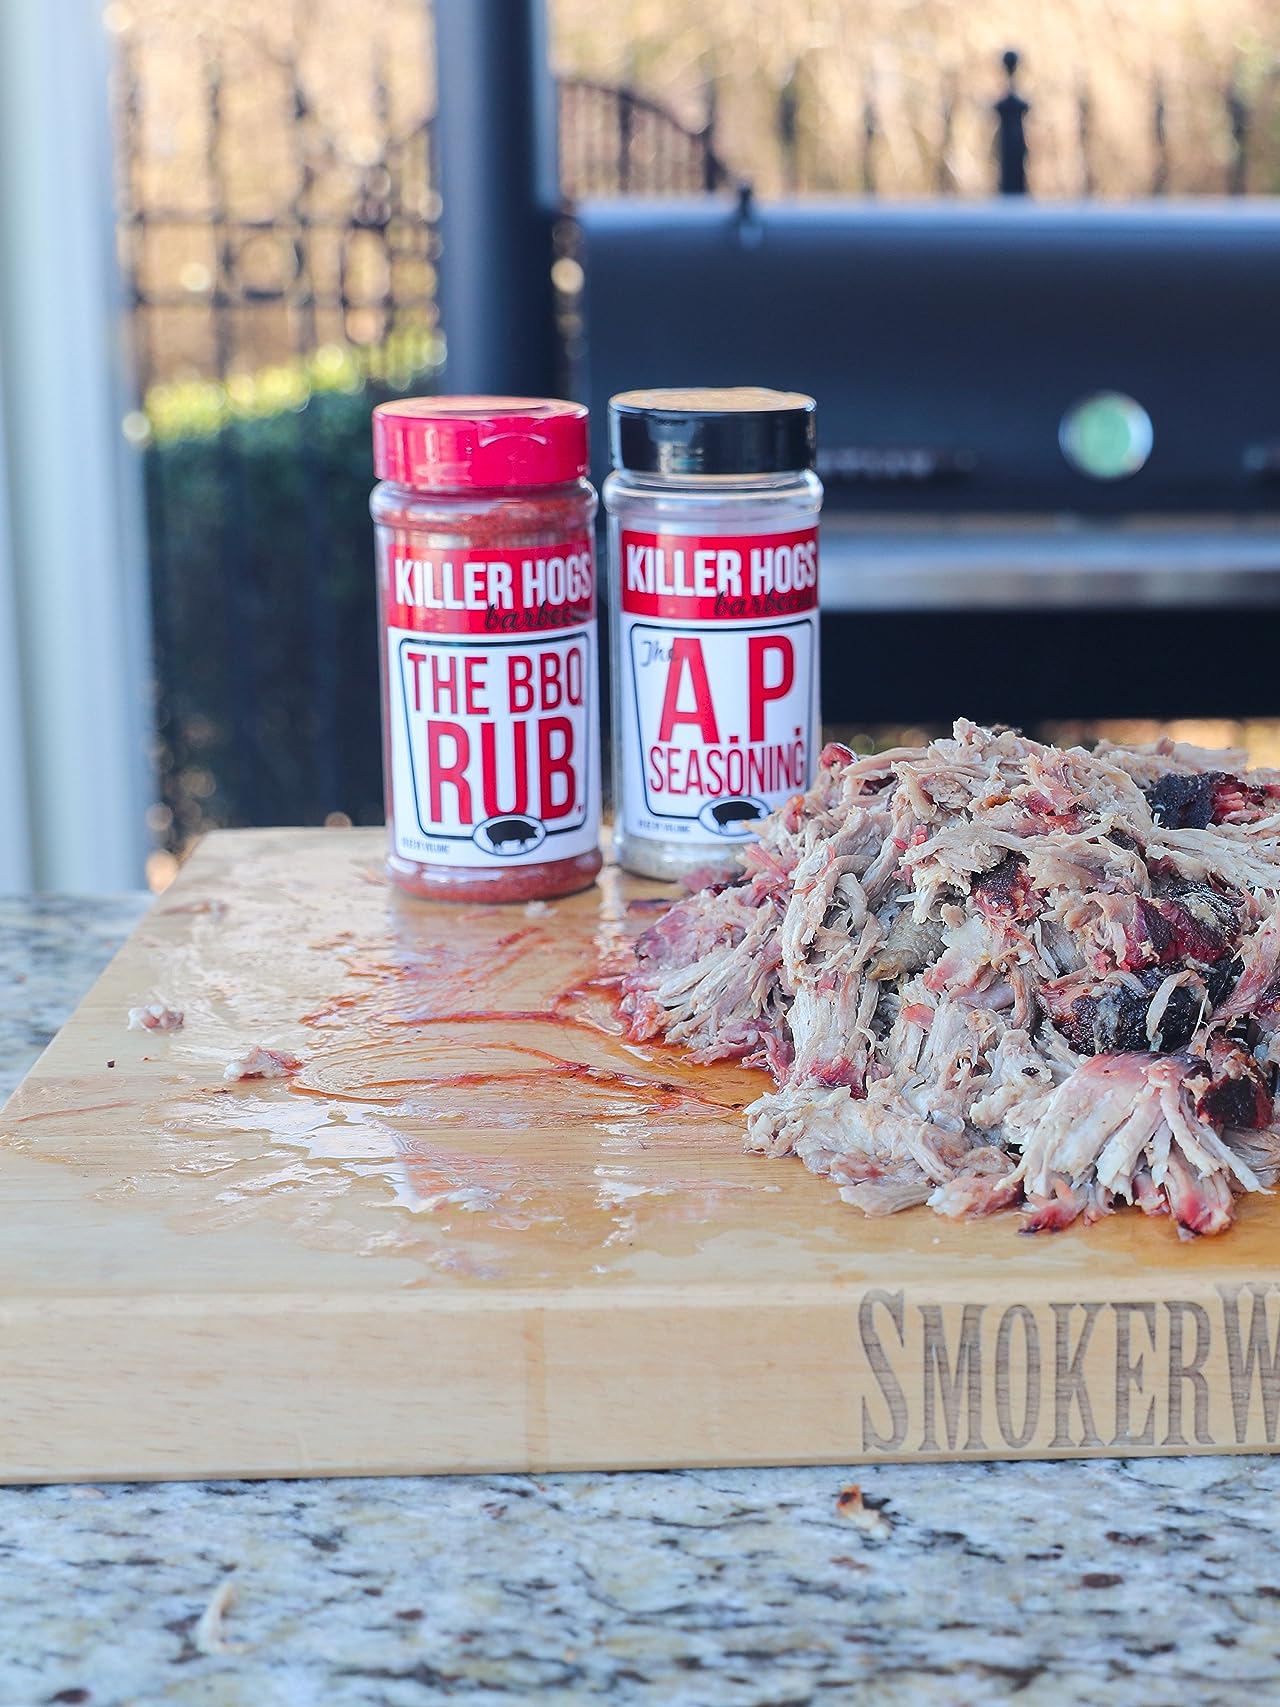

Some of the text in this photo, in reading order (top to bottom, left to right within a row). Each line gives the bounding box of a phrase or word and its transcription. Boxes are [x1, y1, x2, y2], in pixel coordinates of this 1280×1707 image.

[394, 551, 592, 611] KILLER HOGS
[626, 542, 816, 598] KILLER HOGS
[406, 647, 584, 716] THE BBQ
[659, 635, 801, 743] A.P.
[650, 741, 805, 796] SEASONING
